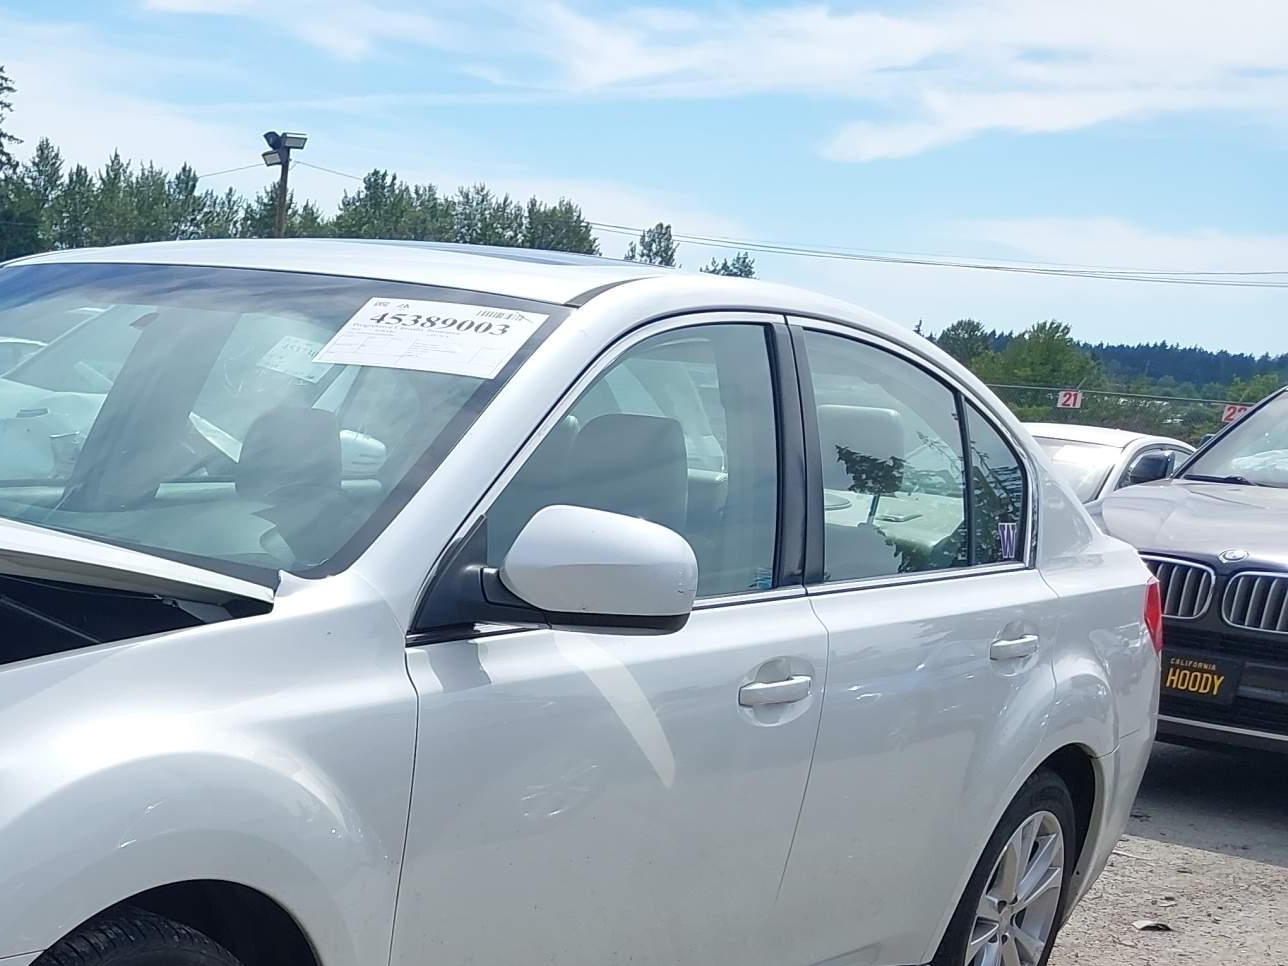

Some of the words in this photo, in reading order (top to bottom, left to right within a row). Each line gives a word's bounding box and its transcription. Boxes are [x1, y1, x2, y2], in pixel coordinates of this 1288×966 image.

[369, 312, 511, 336] 45389003
[1061, 391, 1079, 407] 21
[998, 522, 1017, 559] W
[1170, 657, 1217, 671] CALIFORNIA
[1165, 667, 1225, 696] HOODY
